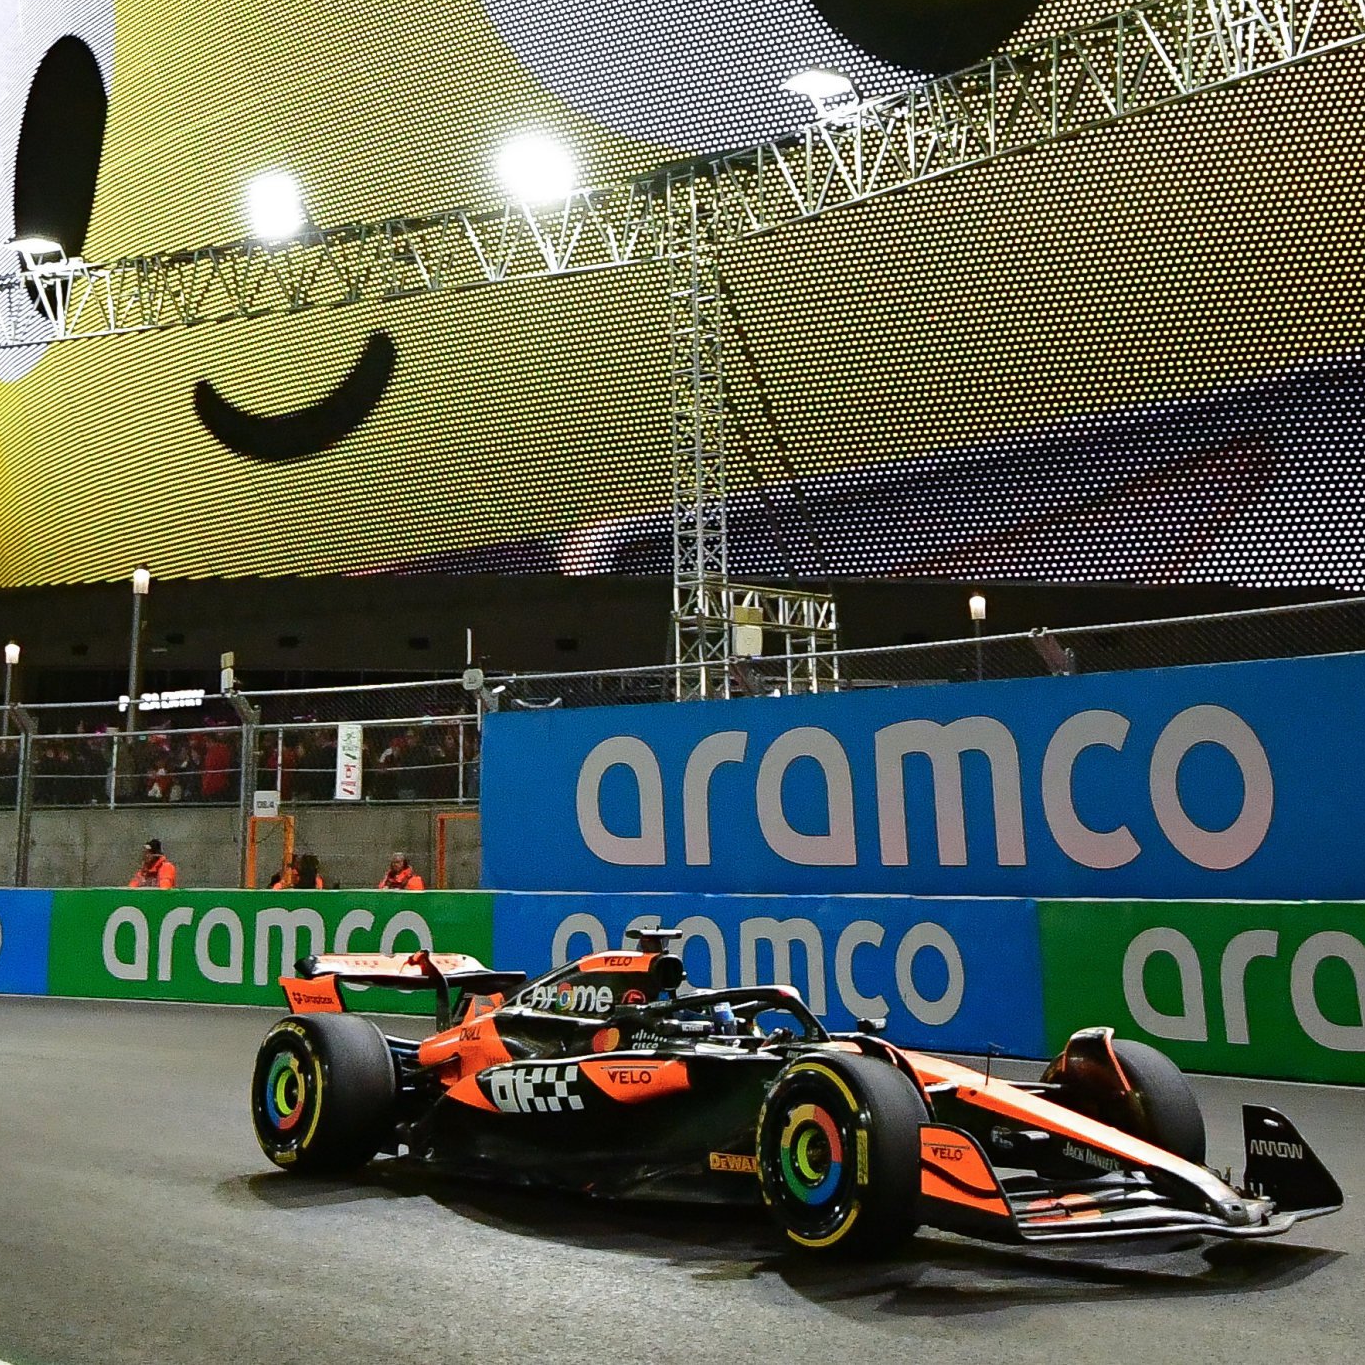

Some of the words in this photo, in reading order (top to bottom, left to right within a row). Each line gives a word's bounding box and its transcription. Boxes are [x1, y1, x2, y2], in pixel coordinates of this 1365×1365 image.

[575, 703, 1274, 871] aramco
[604, 957, 633, 967] VELO
[608, 1070, 652, 1084] VELO
[491, 1065, 584, 1113] OKX
[931, 1146, 963, 1161] VELO
[1063, 1141, 1084, 1161] JACK
[1250, 1139, 1303, 1159] ARROW
